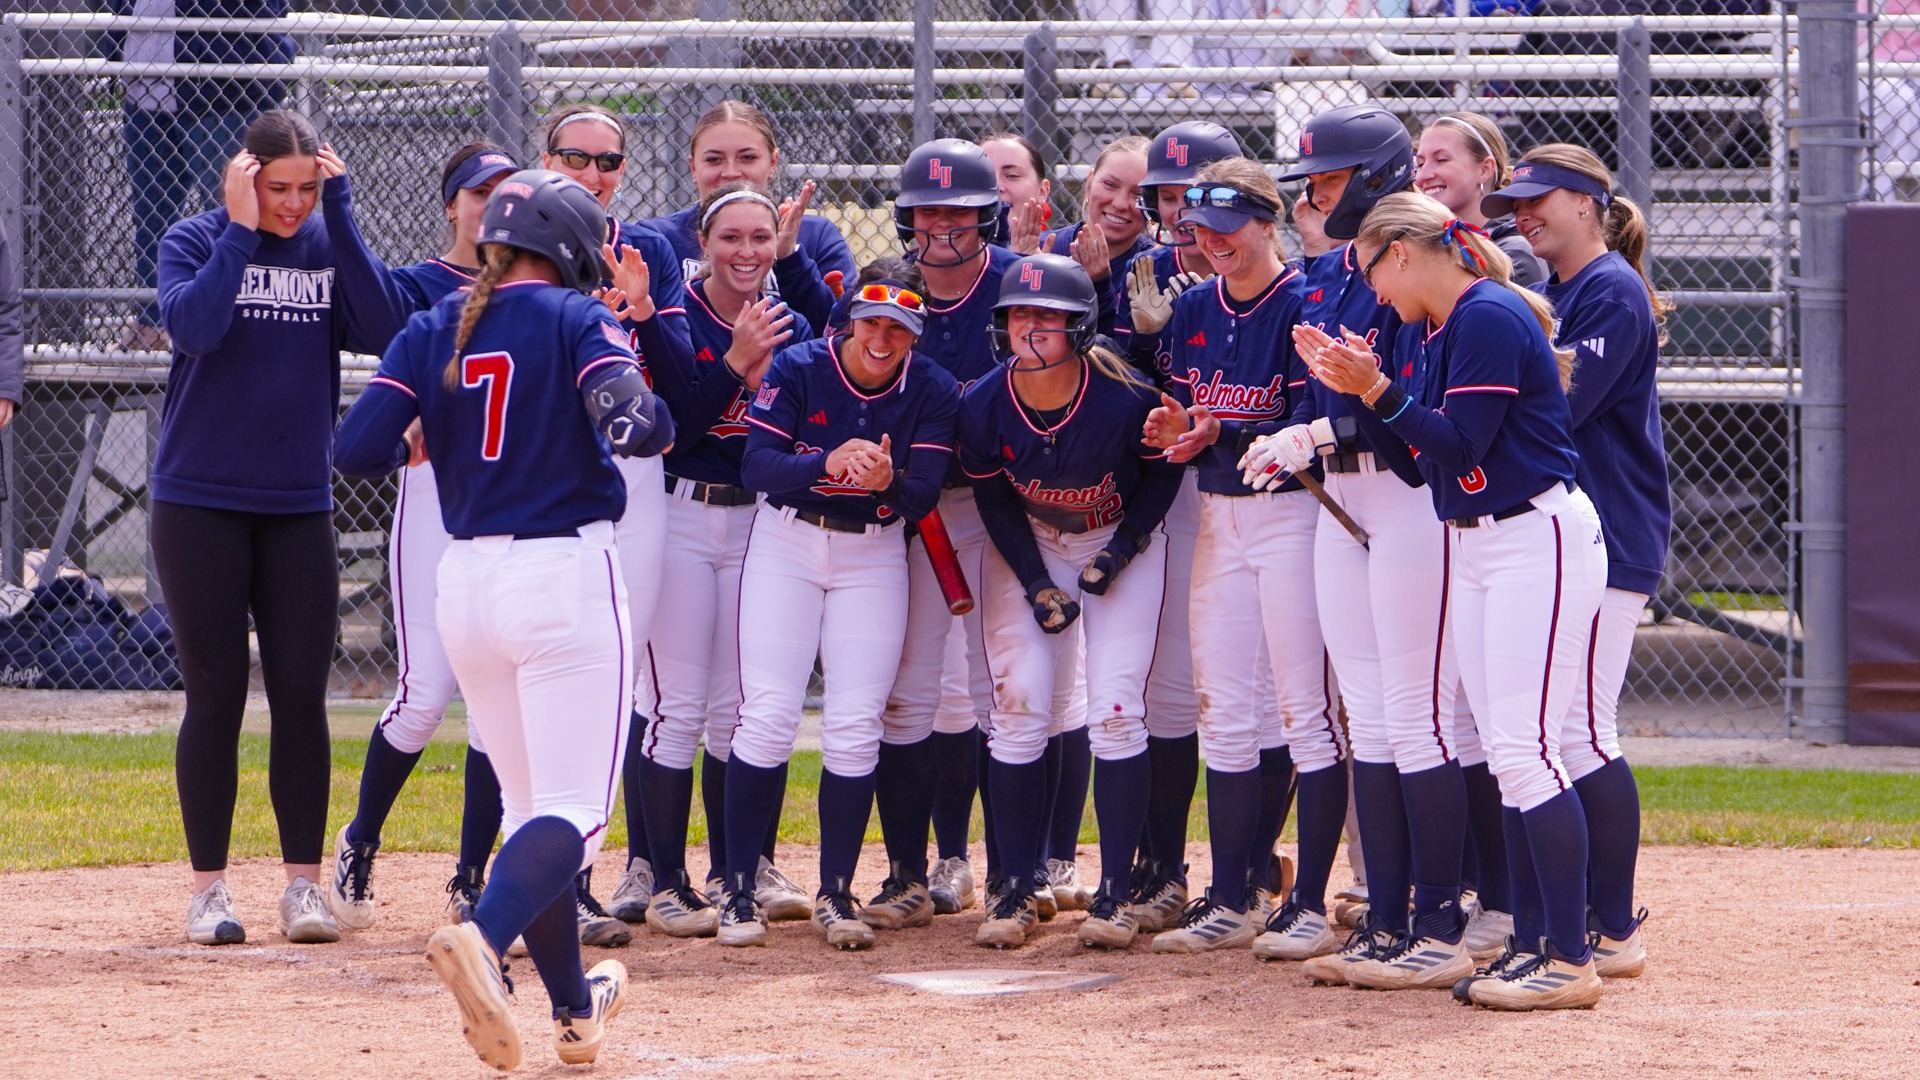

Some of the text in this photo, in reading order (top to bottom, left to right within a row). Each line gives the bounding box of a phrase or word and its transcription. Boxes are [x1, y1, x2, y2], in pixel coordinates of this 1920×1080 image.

[1166, 137, 1189, 166] BU
[929, 158, 953, 188] BU
[504, 202, 514, 217] 1
[1019, 262, 1044, 291] BU
[242, 308, 321, 323] SOFTBALL
[1187, 366, 1284, 413] Belmont
[461, 350, 516, 462] 7
[1004, 467, 1117, 509] elmont
[1085, 492, 1125, 531] 12
